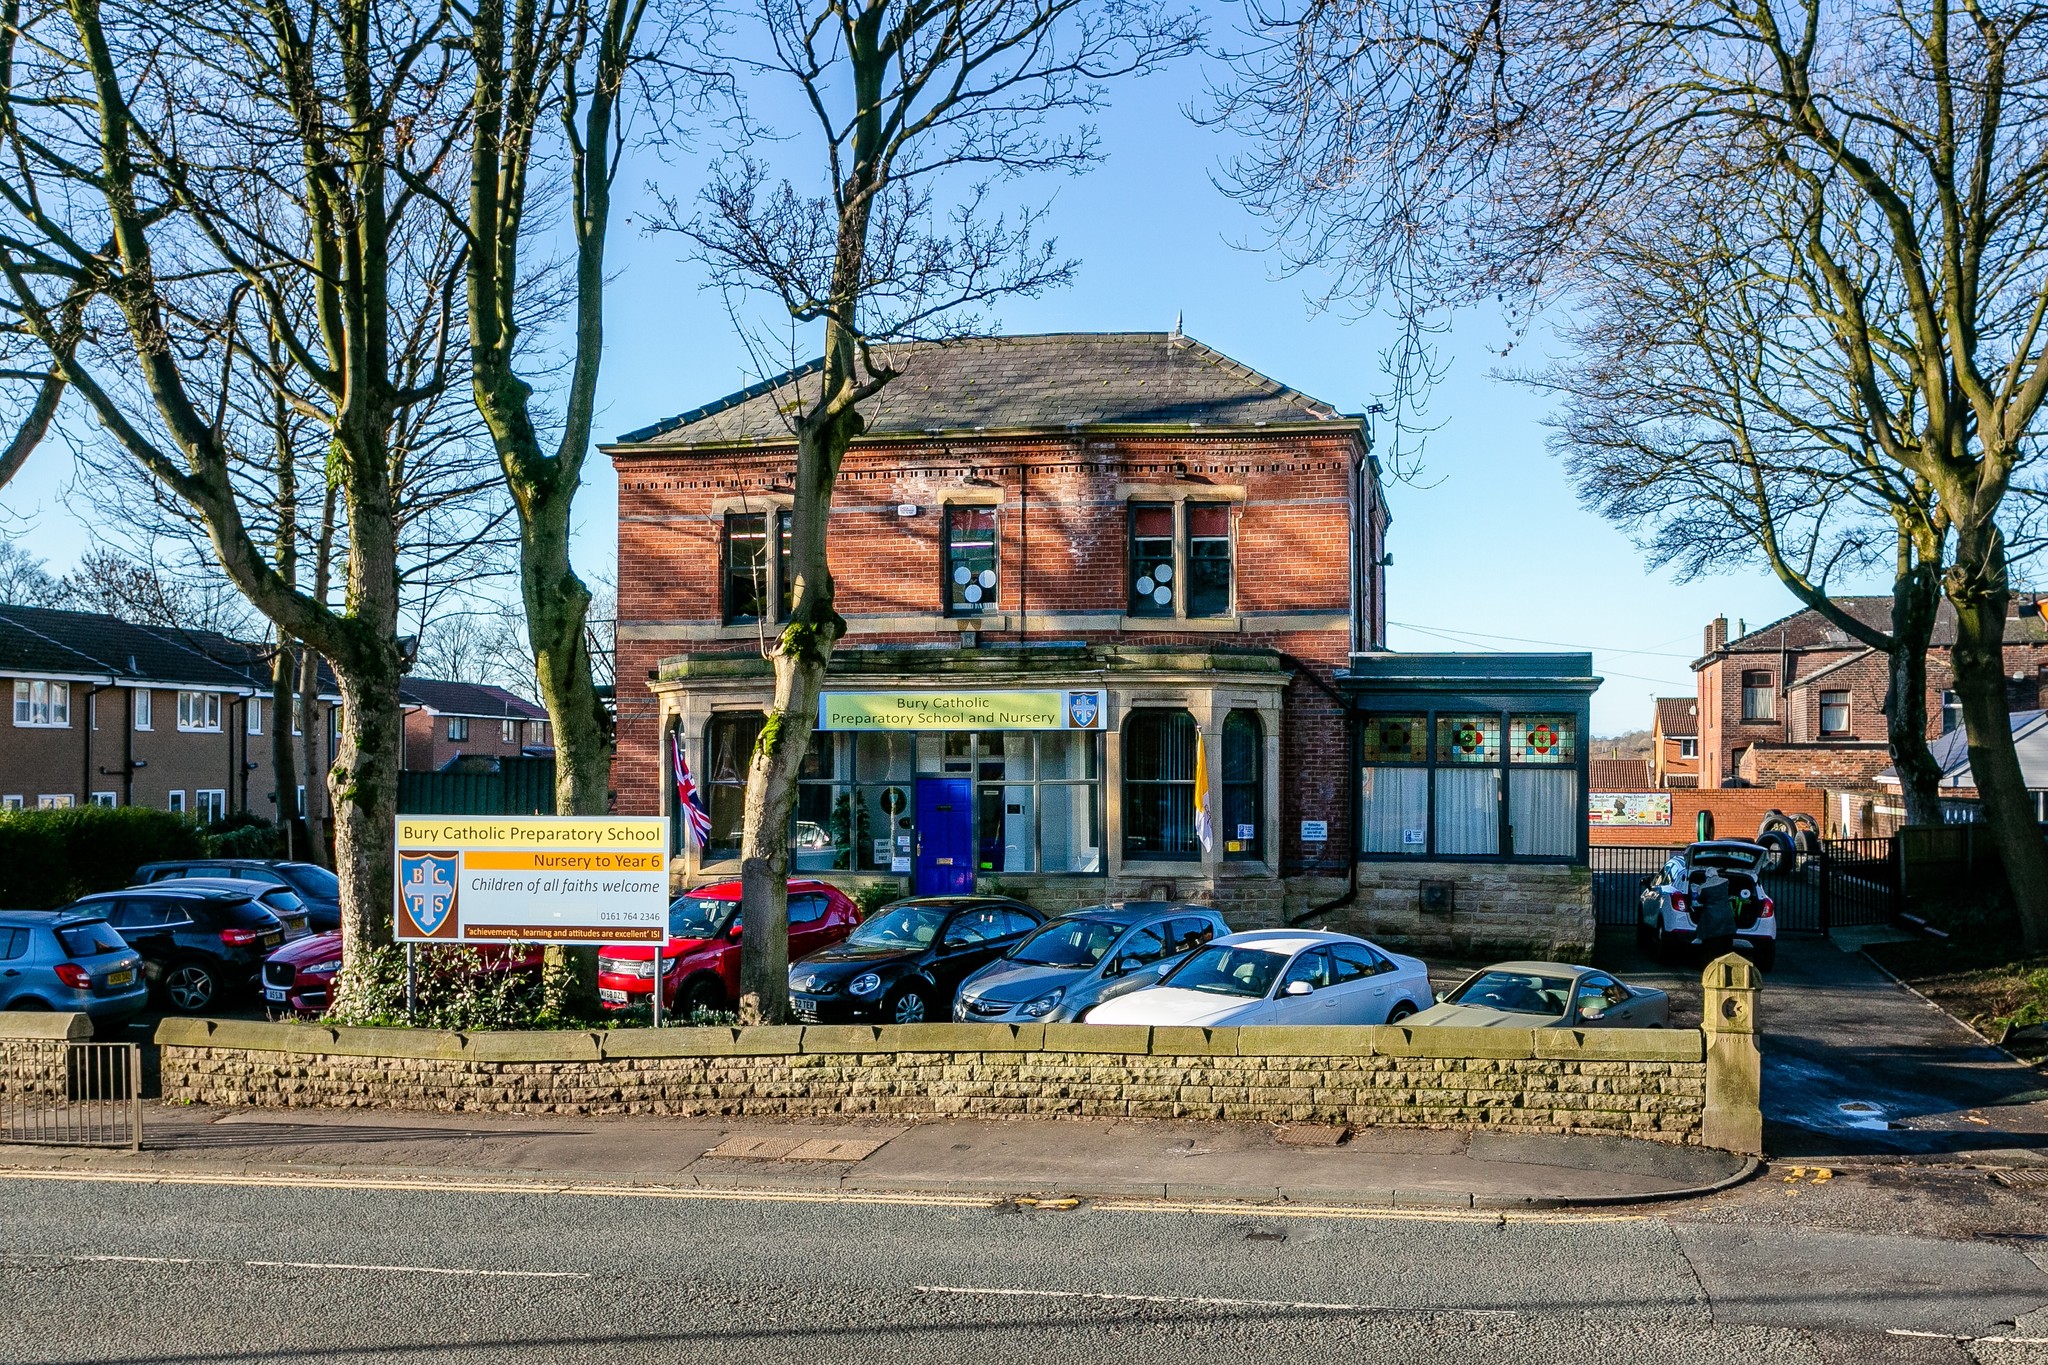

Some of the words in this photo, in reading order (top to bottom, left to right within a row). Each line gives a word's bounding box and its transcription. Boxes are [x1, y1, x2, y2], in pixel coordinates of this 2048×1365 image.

[897, 698, 929, 710] Bury
[933, 697, 990, 709] Catholic
[832, 712, 914, 726] Preparatory
[918, 712, 964, 724] School
[969, 712, 994, 723] and
[999, 712, 1056, 725] Nursery
[403, 826, 439, 842] Bury
[443, 826, 506, 840] Catholic
[510, 827, 603, 843] Preparatory
[607, 827, 661, 841] School
[534, 854, 590, 870] Nursery
[595, 856, 611, 867] to
[615, 855, 646, 867] Year
[651, 855, 661, 867] 6
[413, 868, 423, 883] B
[434, 868, 446, 883] C
[471, 877, 524, 892] Children
[527, 878, 541, 894] of
[543, 878, 560, 892] all
[561, 878, 598, 895] faiths
[602, 879, 660, 893] welcome
[413, 897, 423, 912] P
[434, 897, 444, 912] S
[600, 912, 621, 921] 0161
[623, 912, 638, 921] 764
[640, 912, 660, 921] 2346
[523, 928, 552, 938] learning
[553, 928, 567, 937] and
[568, 929, 600, 938] attitudes
[601, 930, 614, 938] are
[651, 930, 660, 938] ISI
[802, 1000, 815, 1009] TER
